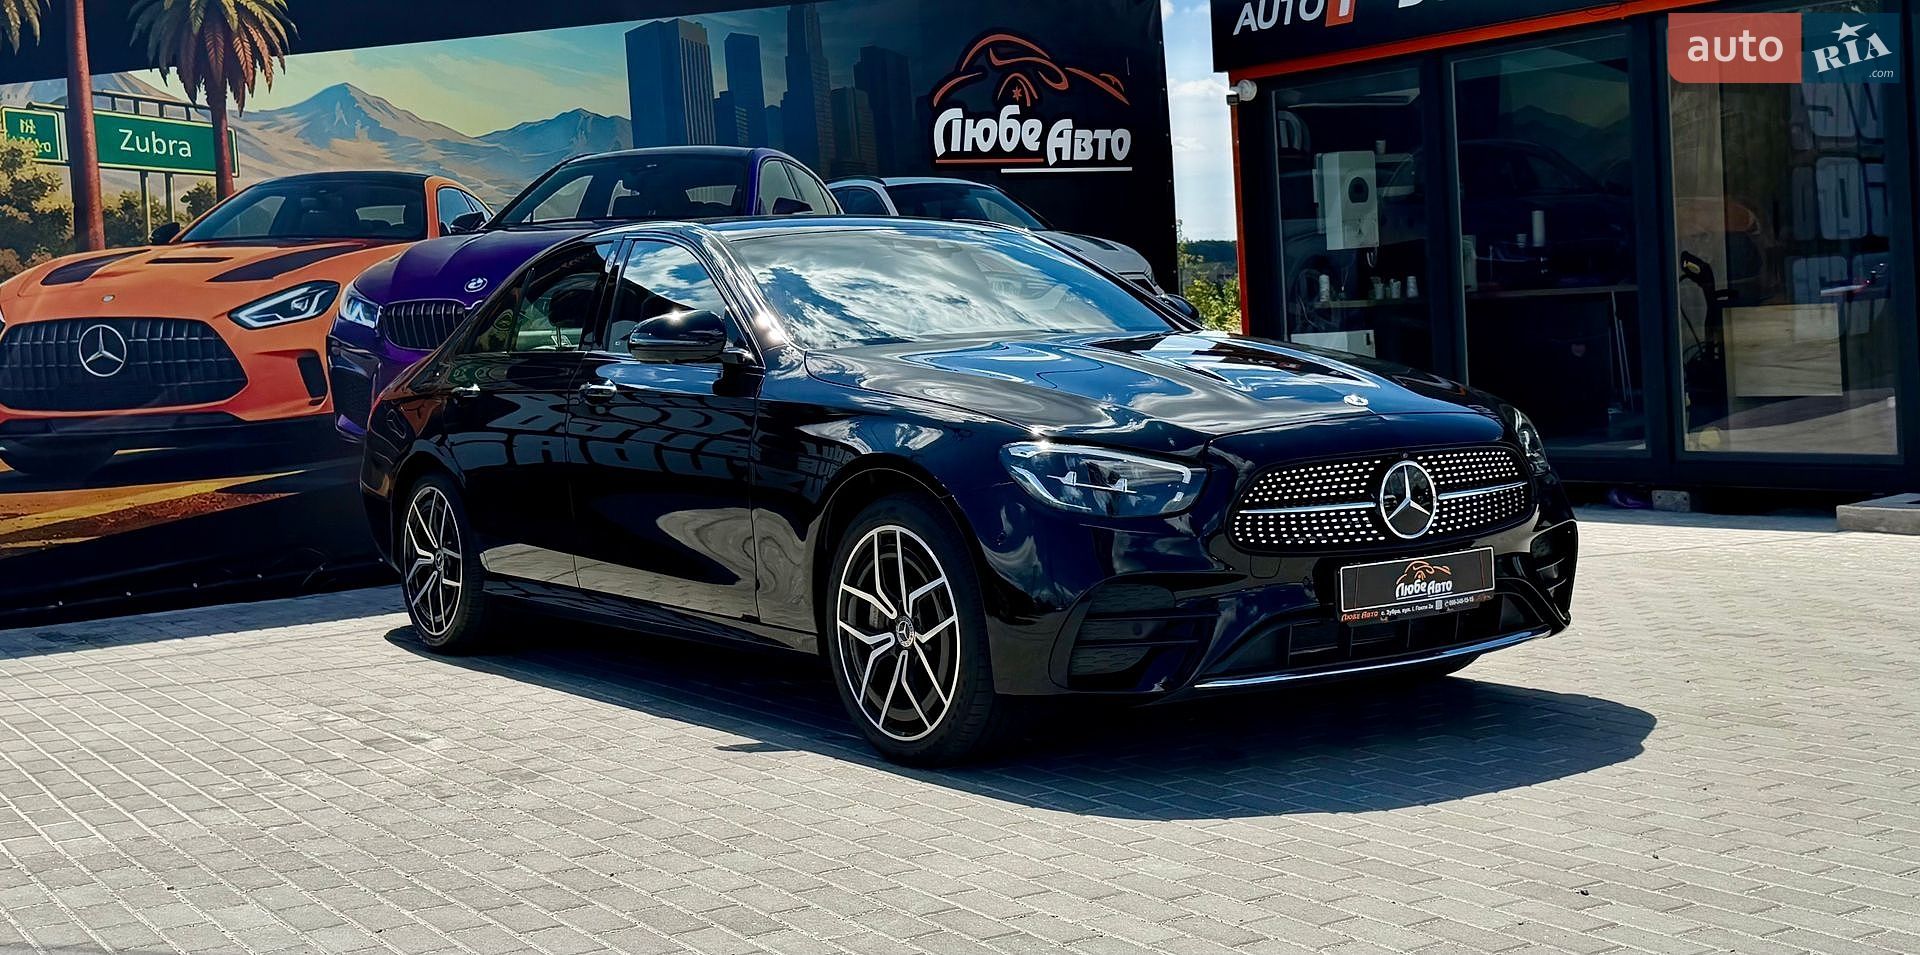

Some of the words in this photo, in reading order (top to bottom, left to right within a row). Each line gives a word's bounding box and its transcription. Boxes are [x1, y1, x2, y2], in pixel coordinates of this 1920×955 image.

[118, 128, 192, 157] Zubra
[933, 104, 1043, 157] Любе
[1395, 579, 1427, 599] Любе
